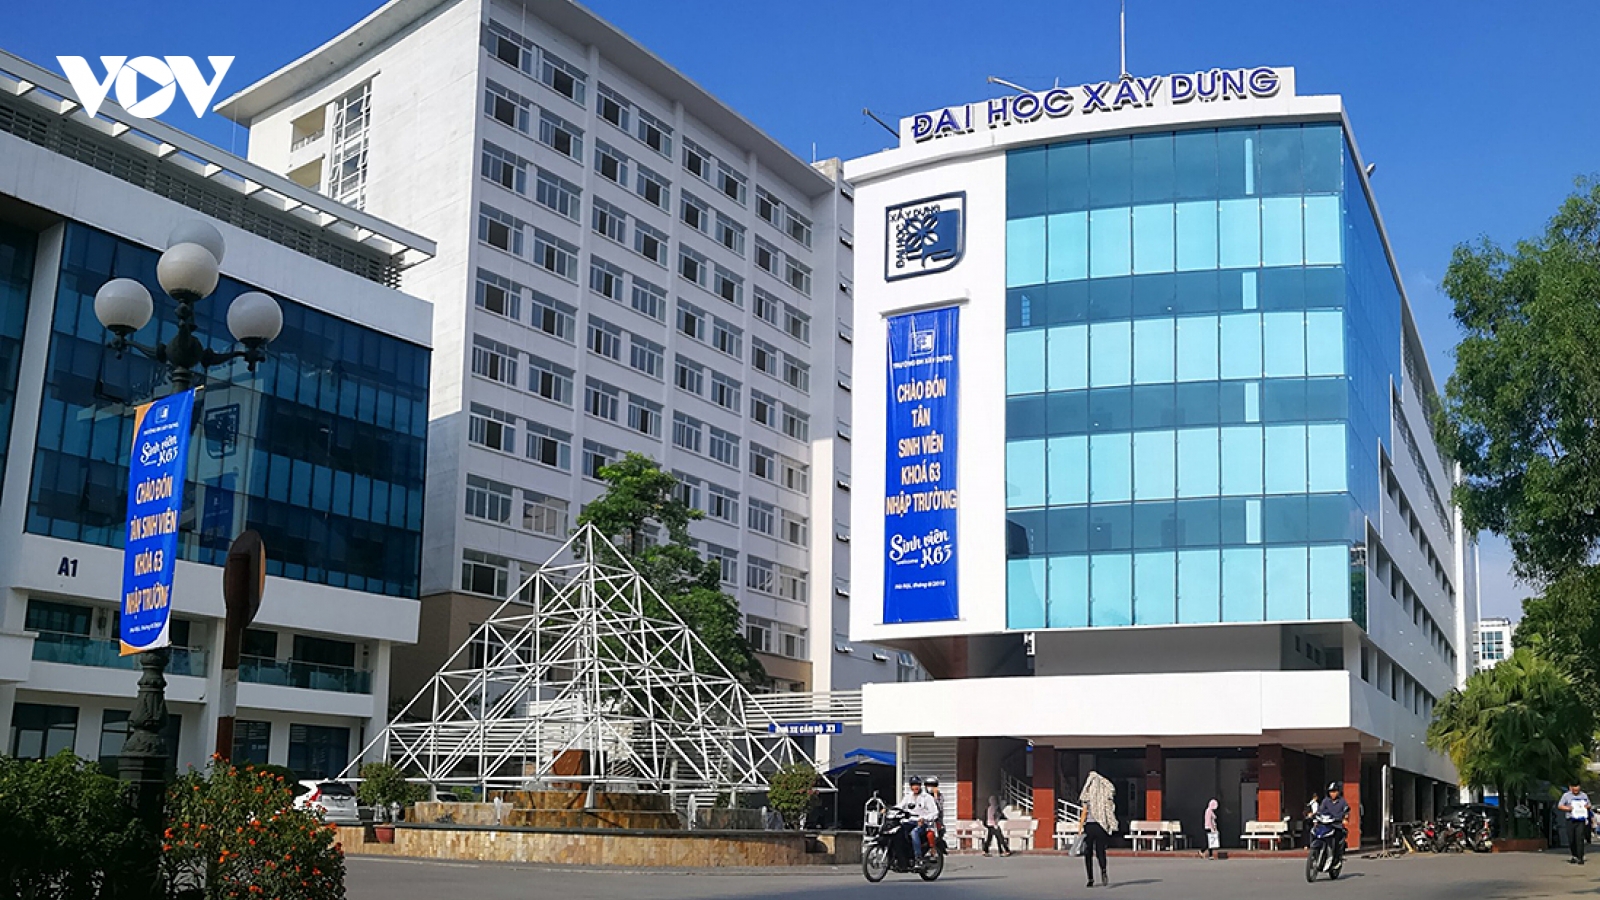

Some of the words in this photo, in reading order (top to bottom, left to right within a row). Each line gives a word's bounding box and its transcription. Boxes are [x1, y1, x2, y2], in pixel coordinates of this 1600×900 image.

[897, 377, 924, 402] CHÀO
[925, 373, 947, 399] ĐÓN
[911, 404, 931, 428] TÂN
[898, 437, 920, 459] SINH
[921, 429, 944, 455] VIÊN
[901, 458, 928, 486] KHOÁ
[928, 461, 941, 482] 63
[136, 476, 155, 505] CHÀO
[155, 472, 173, 500] ĐÓN
[885, 490, 912, 518] NHẬP
[912, 485, 957, 512] TRƯỜNG
[142, 514, 158, 539] SINH
[158, 506, 178, 535] VIÊN
[889, 533, 922, 562] Sinh
[923, 527, 950, 547] viên
[57, 556, 78, 578] A1
[153, 549, 164, 573] 63
[124, 585, 142, 620] NHẬP
